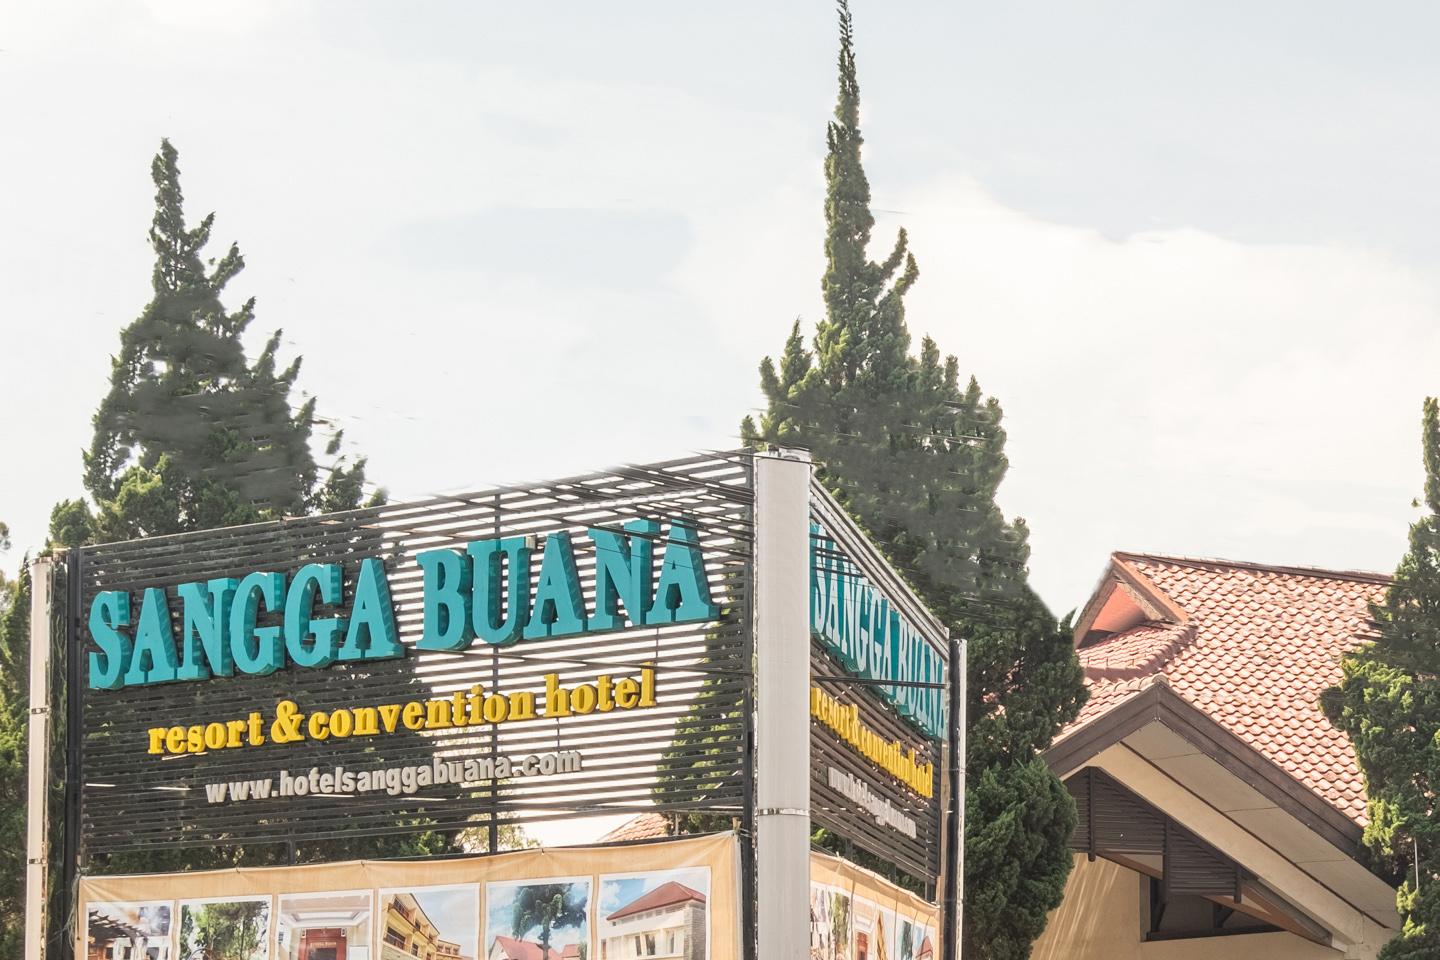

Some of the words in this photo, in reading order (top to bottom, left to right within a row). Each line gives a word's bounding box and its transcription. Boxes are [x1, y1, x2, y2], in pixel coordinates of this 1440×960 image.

[89, 557, 405, 690] SANGGA
[415, 518, 720, 651] BUANA
[810, 524, 893, 696] SANGGA
[148, 712, 265, 755] resort
[543, 661, 658, 719] hotel
[809, 686, 851, 740] resort
[907, 748, 934, 799] hotel
[205, 750, 583, 804] www.hotelsanggabuana.com
